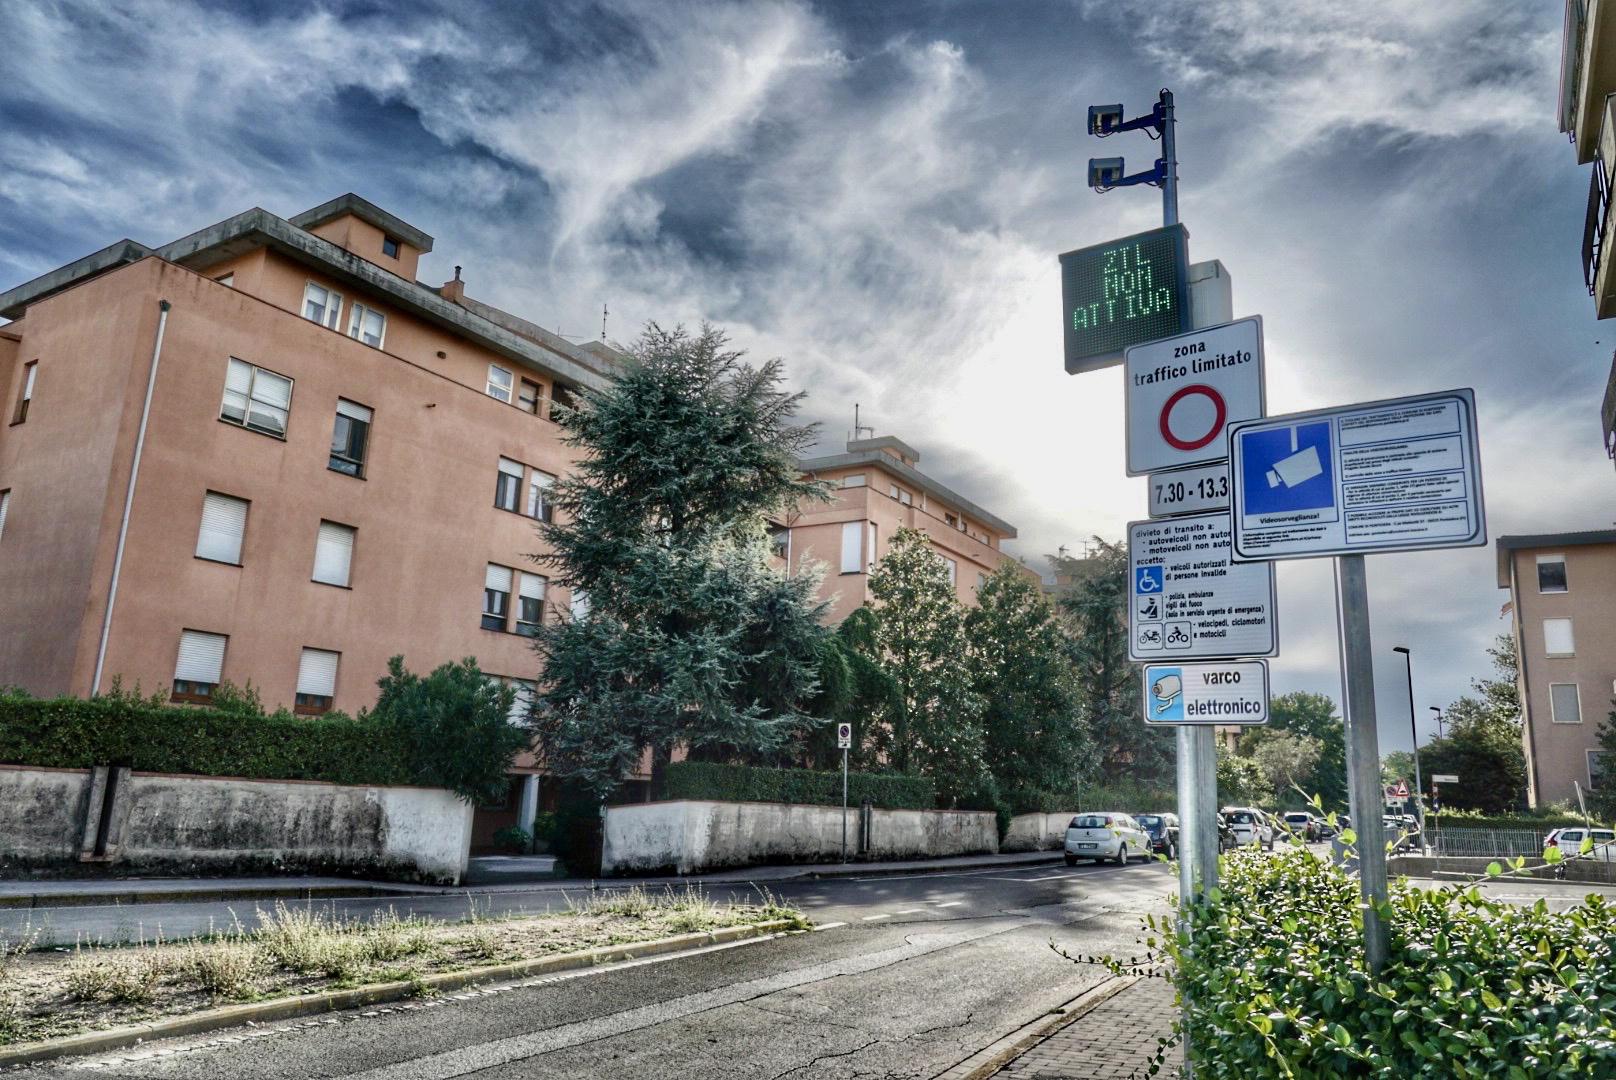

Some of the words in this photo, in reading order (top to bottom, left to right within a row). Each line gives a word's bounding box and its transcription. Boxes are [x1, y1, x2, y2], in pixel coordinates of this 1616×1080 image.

[1103, 244, 1151, 274] ZTL
[1104, 266, 1152, 298] NON
[1174, 341, 1206, 358] zona
[1134, 365, 1187, 386] traffico
[1192, 350, 1251, 374] limitato
[1155, 481, 1185, 504] 7.30
[1198, 476, 1228, 499] 13.3
[1259, 512, 1320, 525] Videosorveglianza!
[1136, 529, 1161, 538] divieto
[1164, 527, 1171, 535] di
[1175, 523, 1205, 533] transito
[1149, 535, 1189, 546] autoveicoli
[1149, 543, 1192, 555] motoveicoli
[1195, 542, 1209, 550] non
[1136, 556, 1166, 566] eccetto:
[1170, 562, 1190, 571] veicoli
[1193, 559, 1226, 570] autorizzati
[1165, 573, 1171, 581] di
[1174, 571, 1198, 581] persone
[1201, 569, 1226, 578] invalide
[1231, 616, 1266, 626] ciclomotori
[1200, 629, 1227, 638] motocicli
[1203, 671, 1241, 685] varco
[1187, 697, 1261, 715] elettronico
